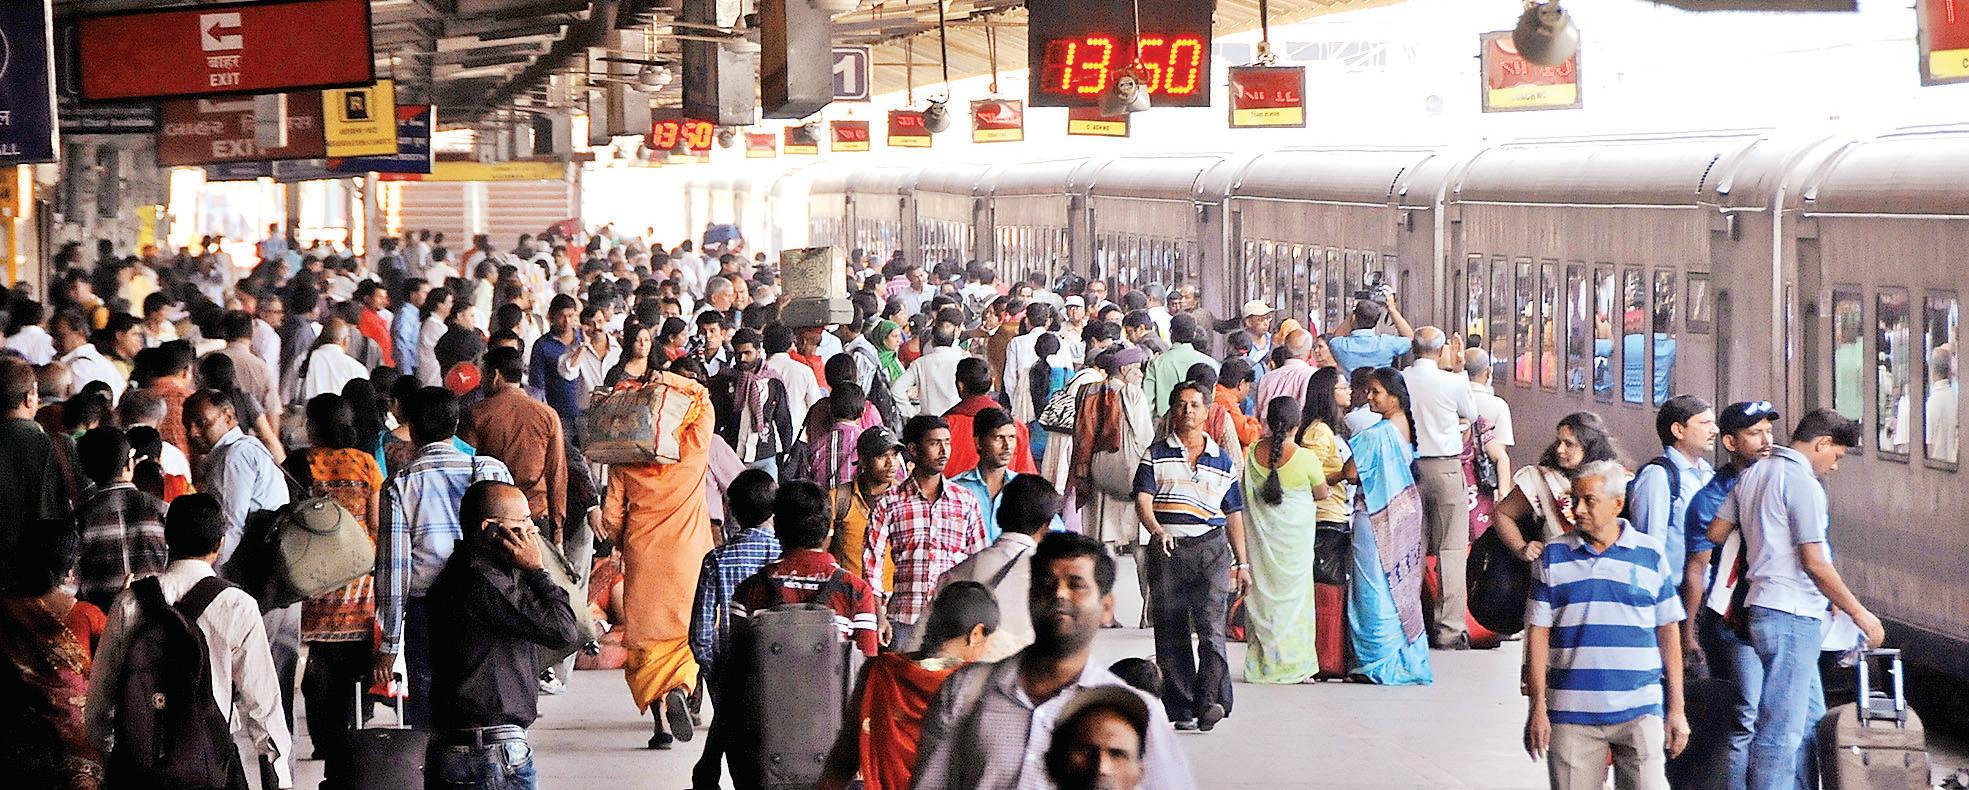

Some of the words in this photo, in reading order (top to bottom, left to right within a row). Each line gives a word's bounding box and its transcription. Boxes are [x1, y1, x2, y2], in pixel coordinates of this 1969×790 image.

[206, 55, 241, 70] बाहर
[209, 72, 240, 86] EXIT
[832, 54, 856, 93] 1
[212, 138, 267, 158] EXI
